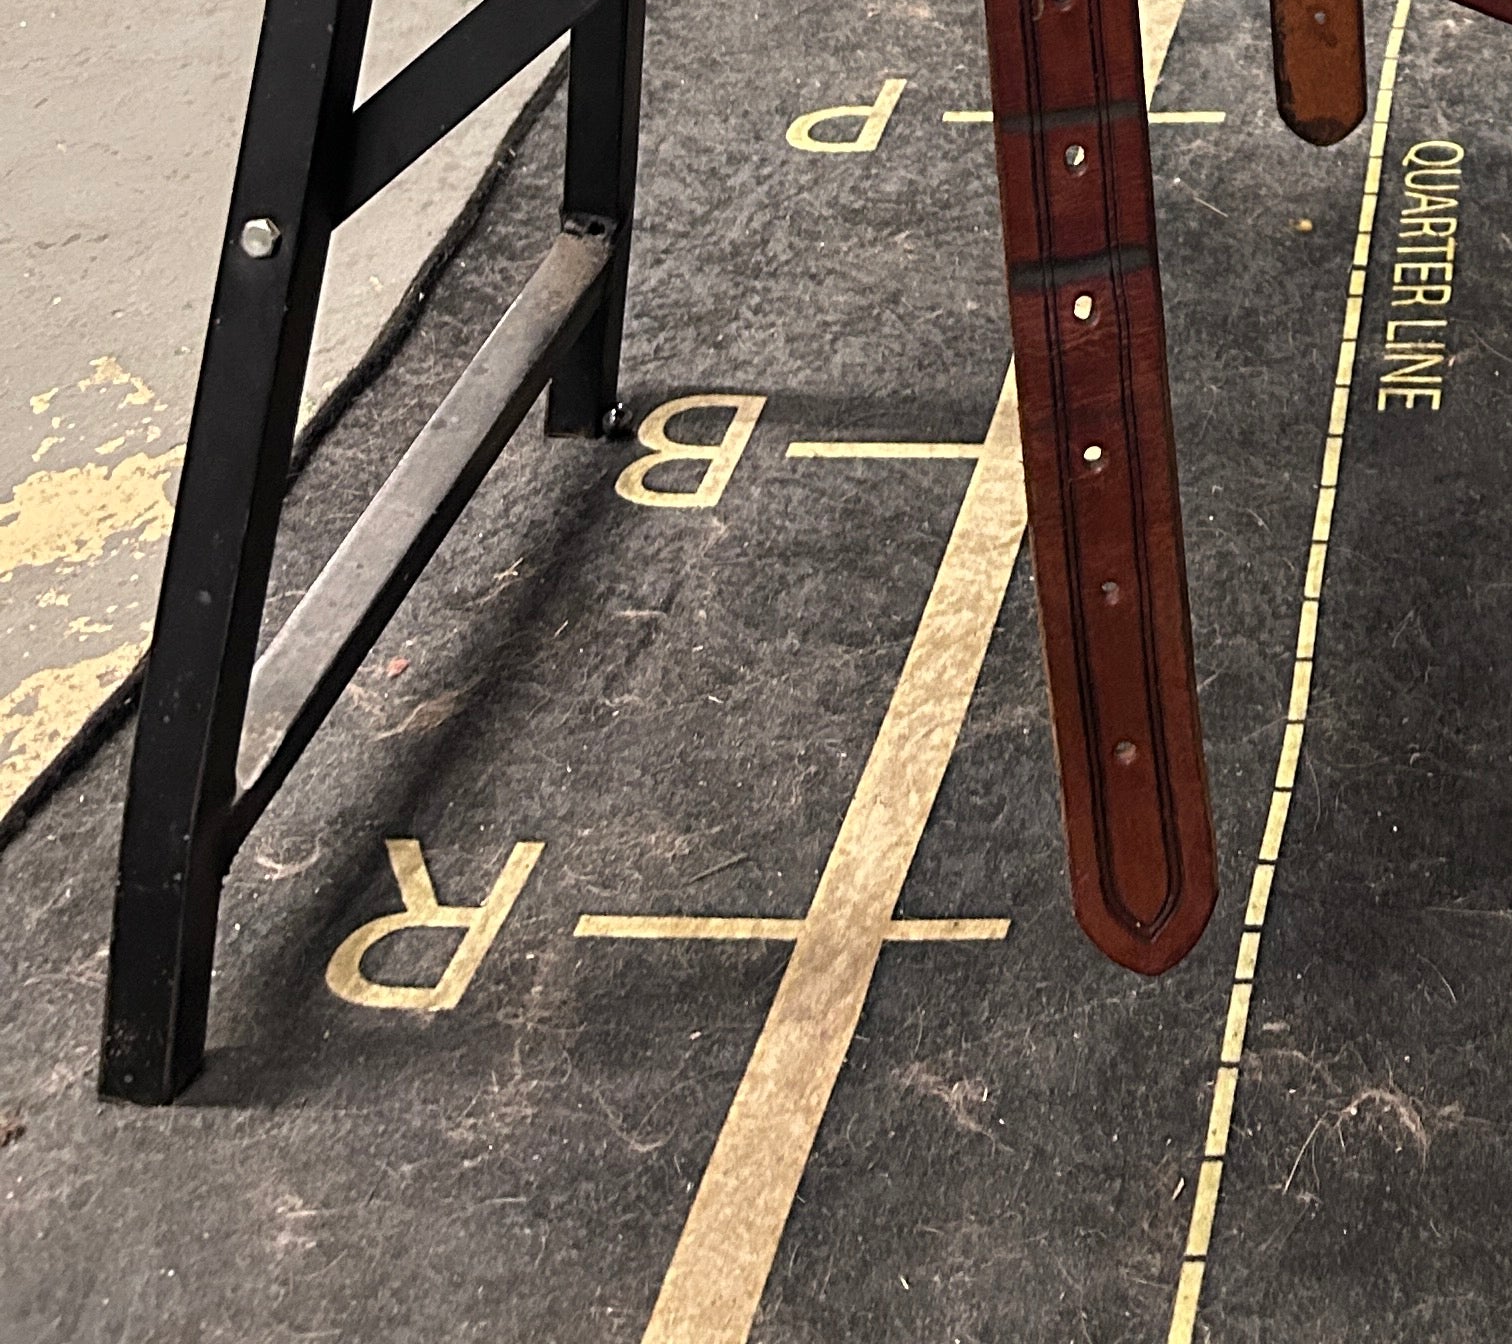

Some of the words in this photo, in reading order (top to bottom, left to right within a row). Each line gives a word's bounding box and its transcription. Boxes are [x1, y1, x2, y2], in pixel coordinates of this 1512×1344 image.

[785, 78, 908, 153] P
[1391, 140, 1465, 307] QUARTER
[1377, 319, 1448, 411] LINE
[613, 393, 768, 508] B
[325, 838, 546, 1011] R
